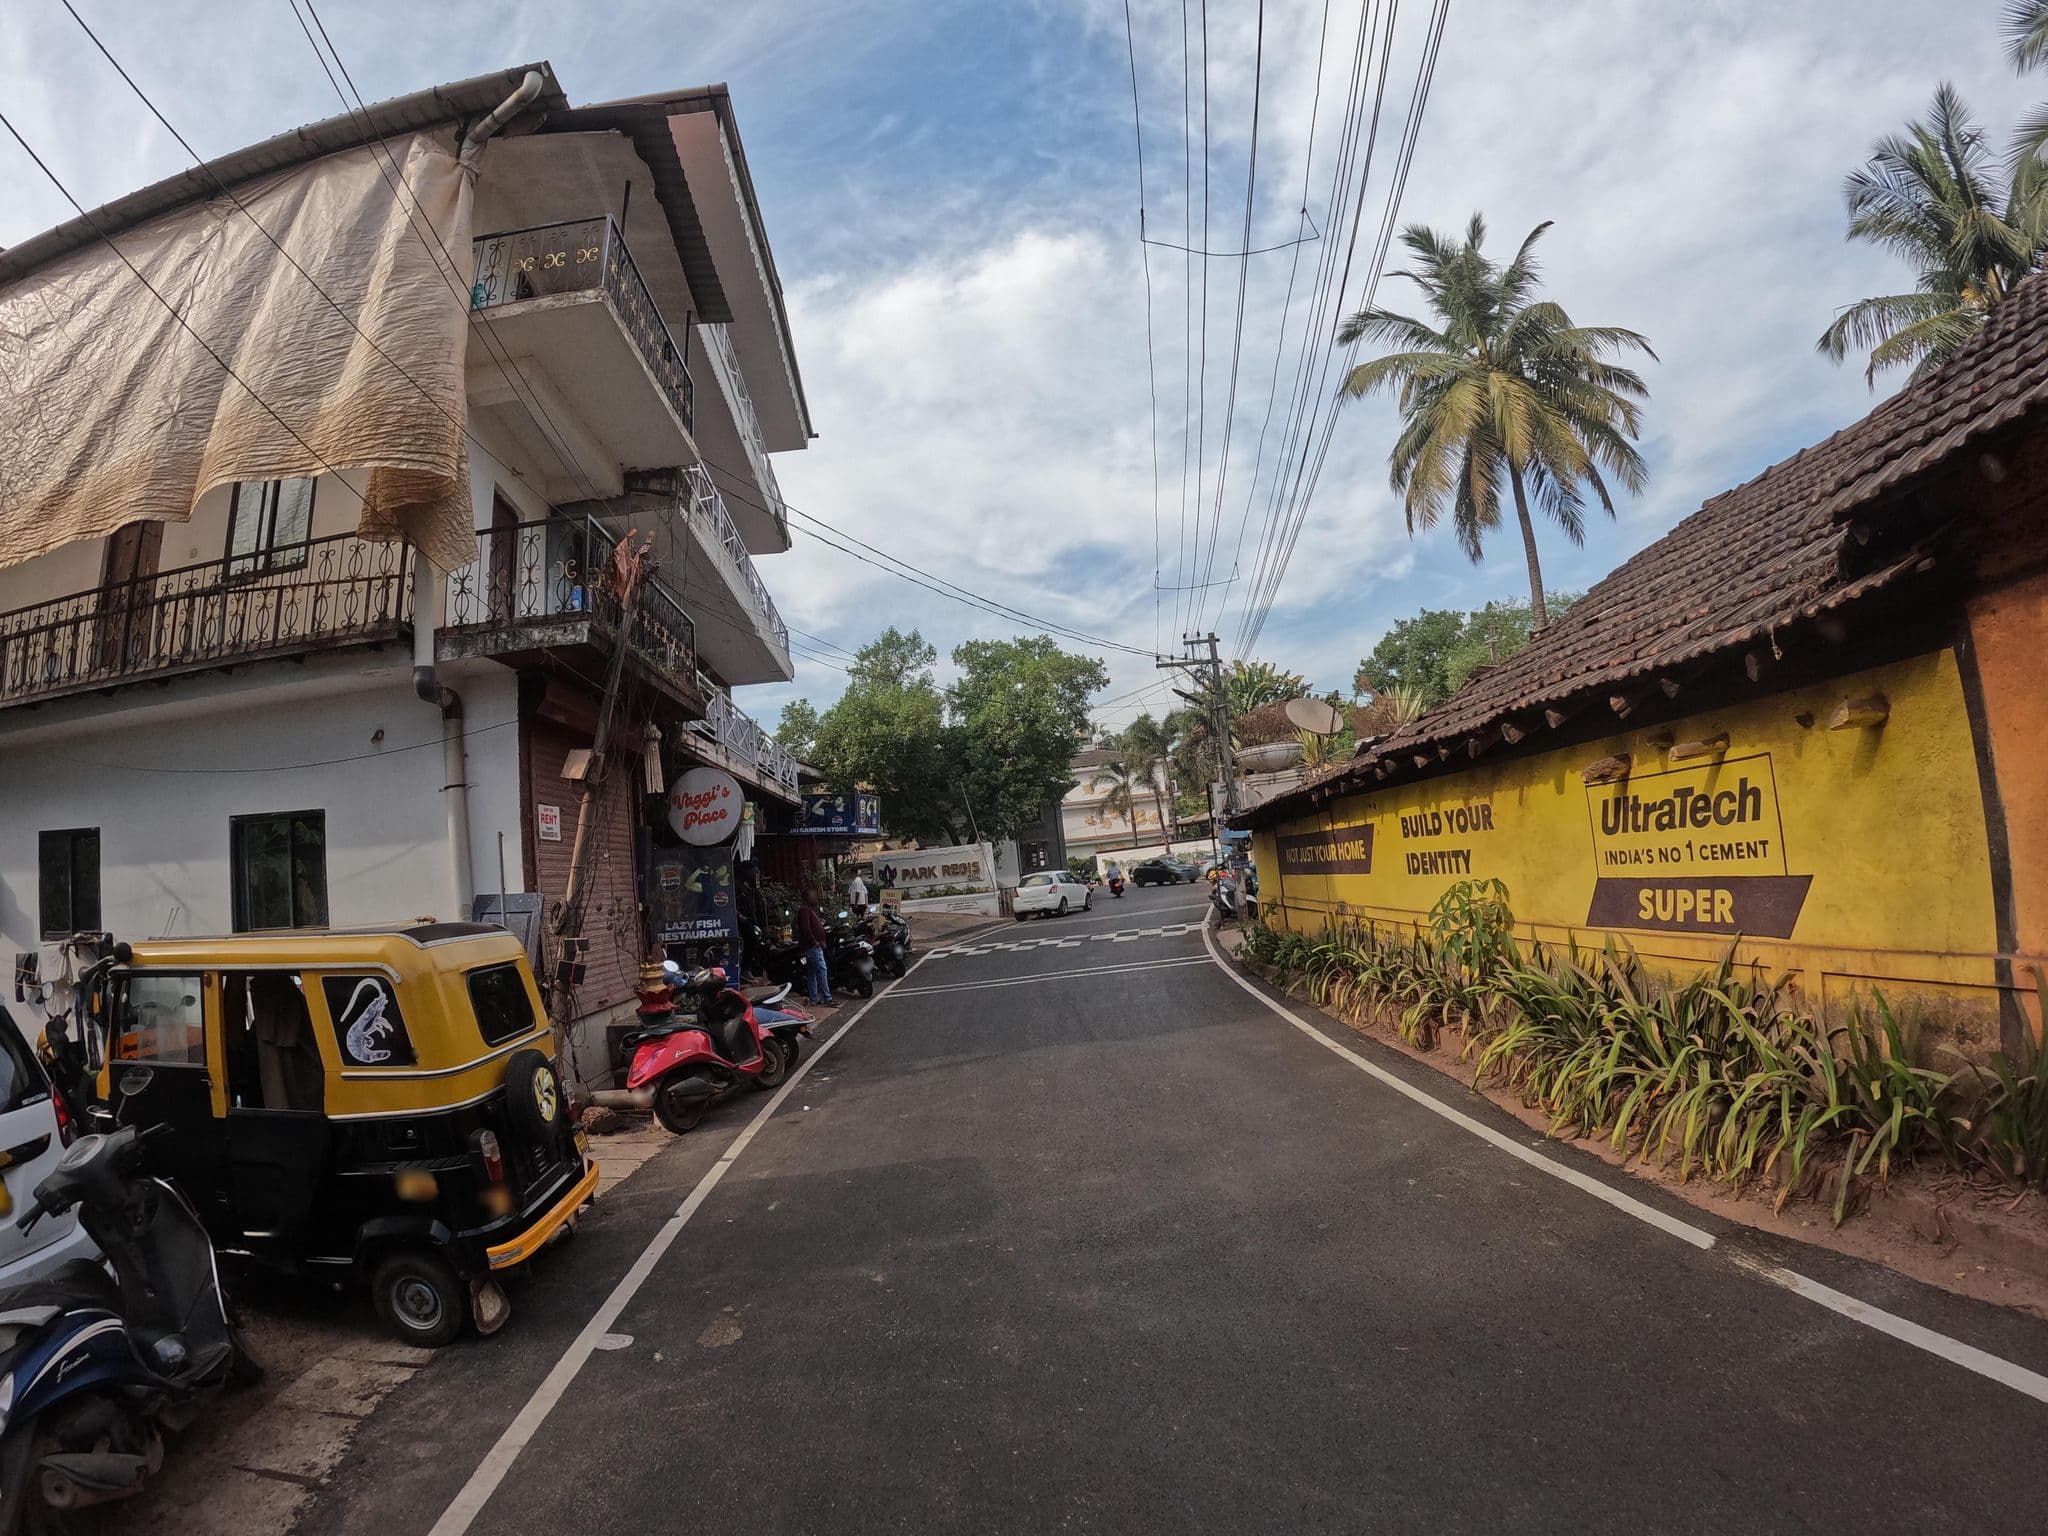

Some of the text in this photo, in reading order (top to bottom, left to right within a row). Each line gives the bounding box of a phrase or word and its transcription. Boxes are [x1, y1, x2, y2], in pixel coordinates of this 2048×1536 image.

[540, 812, 558, 825] RENT
[1601, 777, 1762, 836] UltraTech
[683, 808, 728, 831] Place
[826, 825, 849, 833] STORE
[1401, 803, 1495, 838] BUILD YOUR
[1286, 839, 1367, 864] NOT JUST YOUR HOME
[1406, 849, 1472, 875] IDENTITY
[1604, 840, 1770, 866] INDIA'S NO 1 CEMENT
[901, 861, 980, 880] PARK REGIS
[1638, 888, 1736, 924] SUPER
[657, 928, 730, 941] RESTAURANT
[665, 918, 722, 931] LAZY FISH
